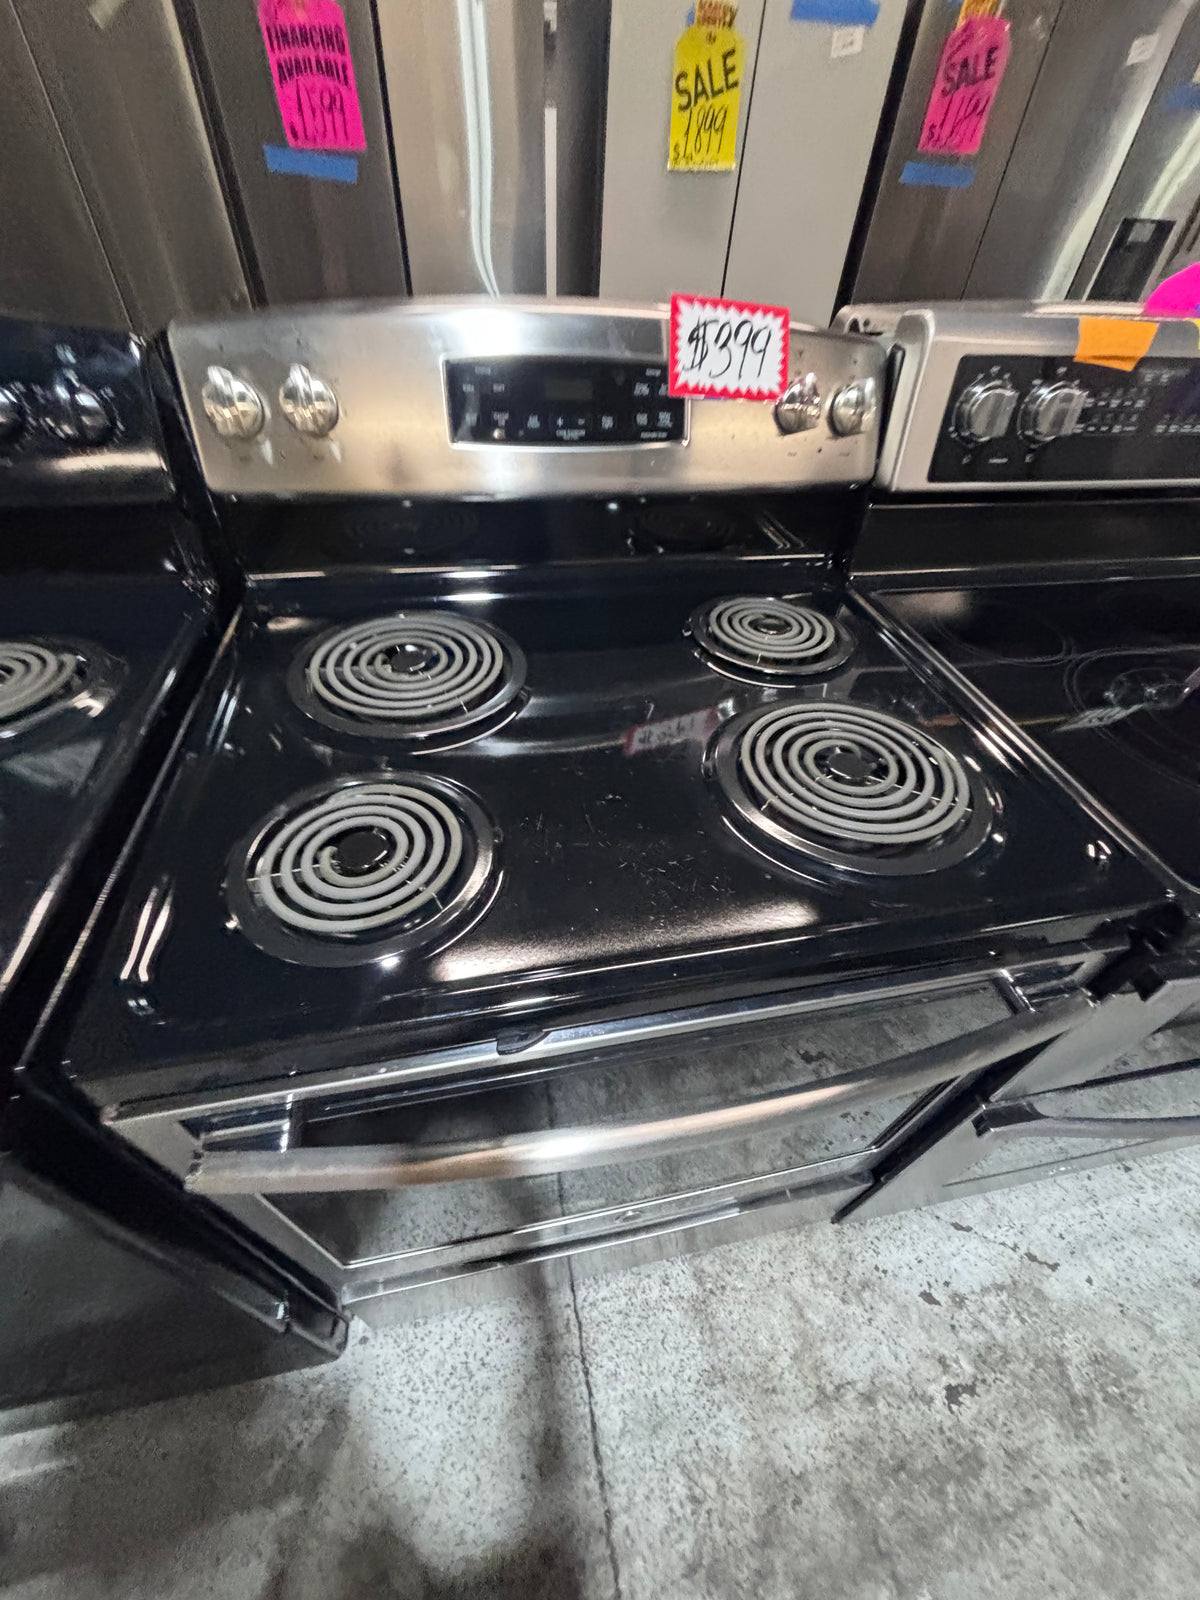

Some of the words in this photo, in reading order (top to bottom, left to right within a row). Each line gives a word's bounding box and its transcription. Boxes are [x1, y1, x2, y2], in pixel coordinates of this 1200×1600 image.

[674, 48, 740, 112] SALE
[942, 46, 998, 97] SALE
[682, 316, 773, 381] $399
